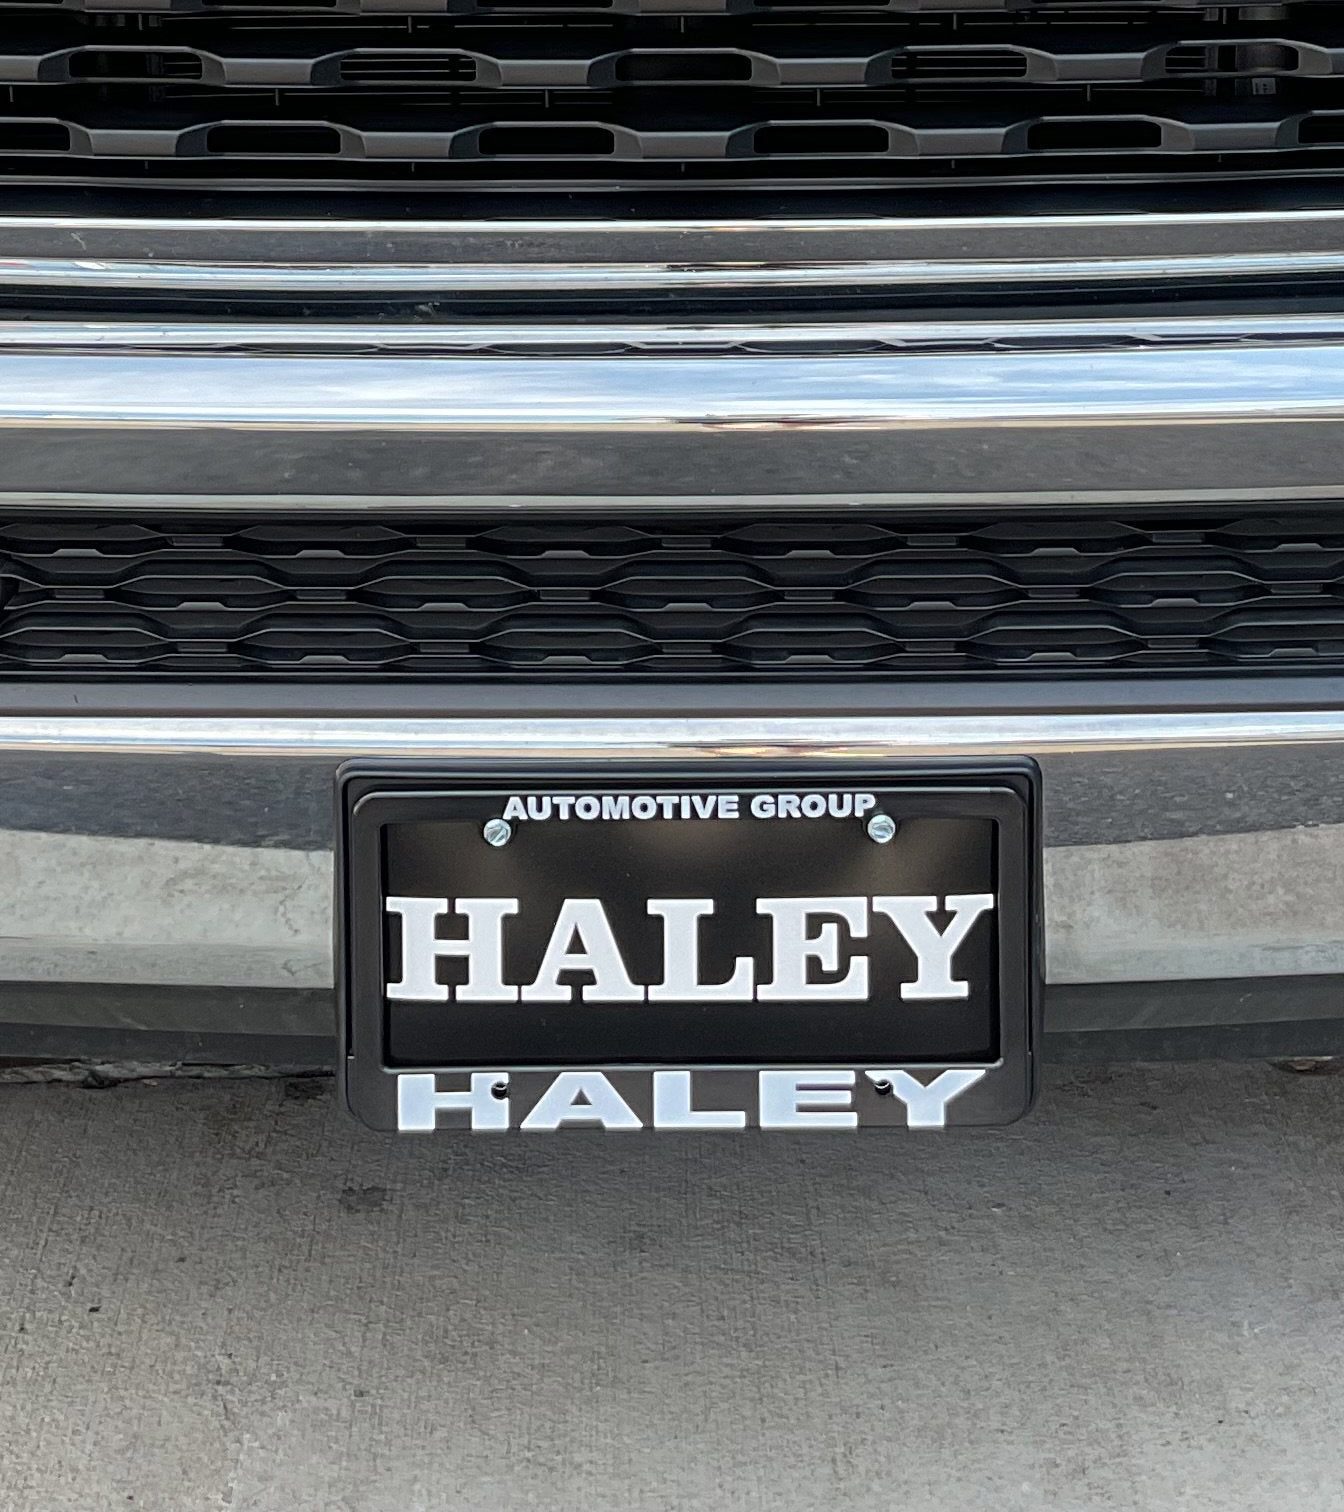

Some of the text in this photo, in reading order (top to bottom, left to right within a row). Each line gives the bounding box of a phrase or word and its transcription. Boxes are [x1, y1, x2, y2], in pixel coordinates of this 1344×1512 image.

[503, 793, 876, 820] AUTOMOTIVE GROUP
[385, 893, 994, 1002] HALEY
[396, 1070, 987, 1130] HALEY
